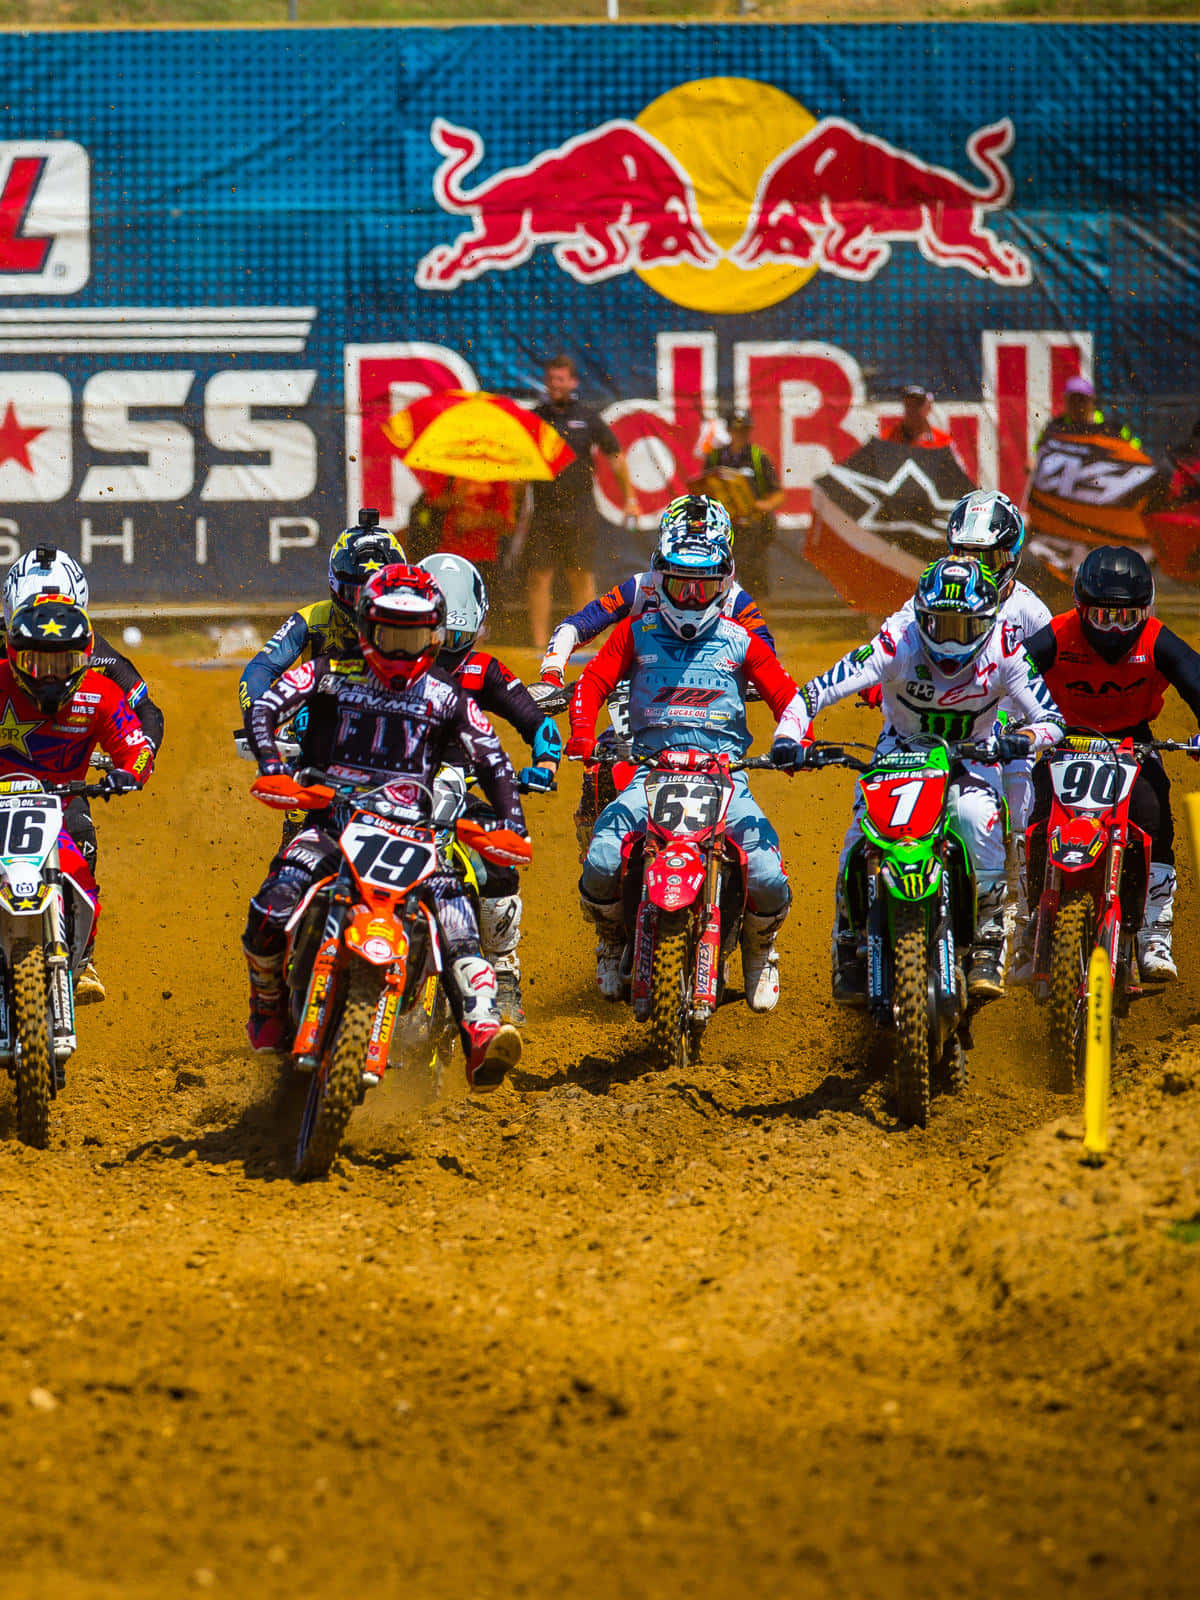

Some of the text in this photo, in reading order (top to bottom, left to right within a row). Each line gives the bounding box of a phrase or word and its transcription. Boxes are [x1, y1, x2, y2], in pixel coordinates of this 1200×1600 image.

[668, 708, 692, 717] LUCAS
[694, 709, 707, 718] OIL
[1073, 752, 1097, 760] LUCAS
[668, 775, 705, 784] LUCAS OIL
[884, 770, 923, 781] LUCAS OIL
[1060, 761, 1127, 805] 90
[21, 799, 35, 807] OIL
[653, 783, 722, 832] 63
[889, 780, 925, 827] 1
[354, 834, 432, 888] 19
[696, 941, 713, 995] VERTEX
